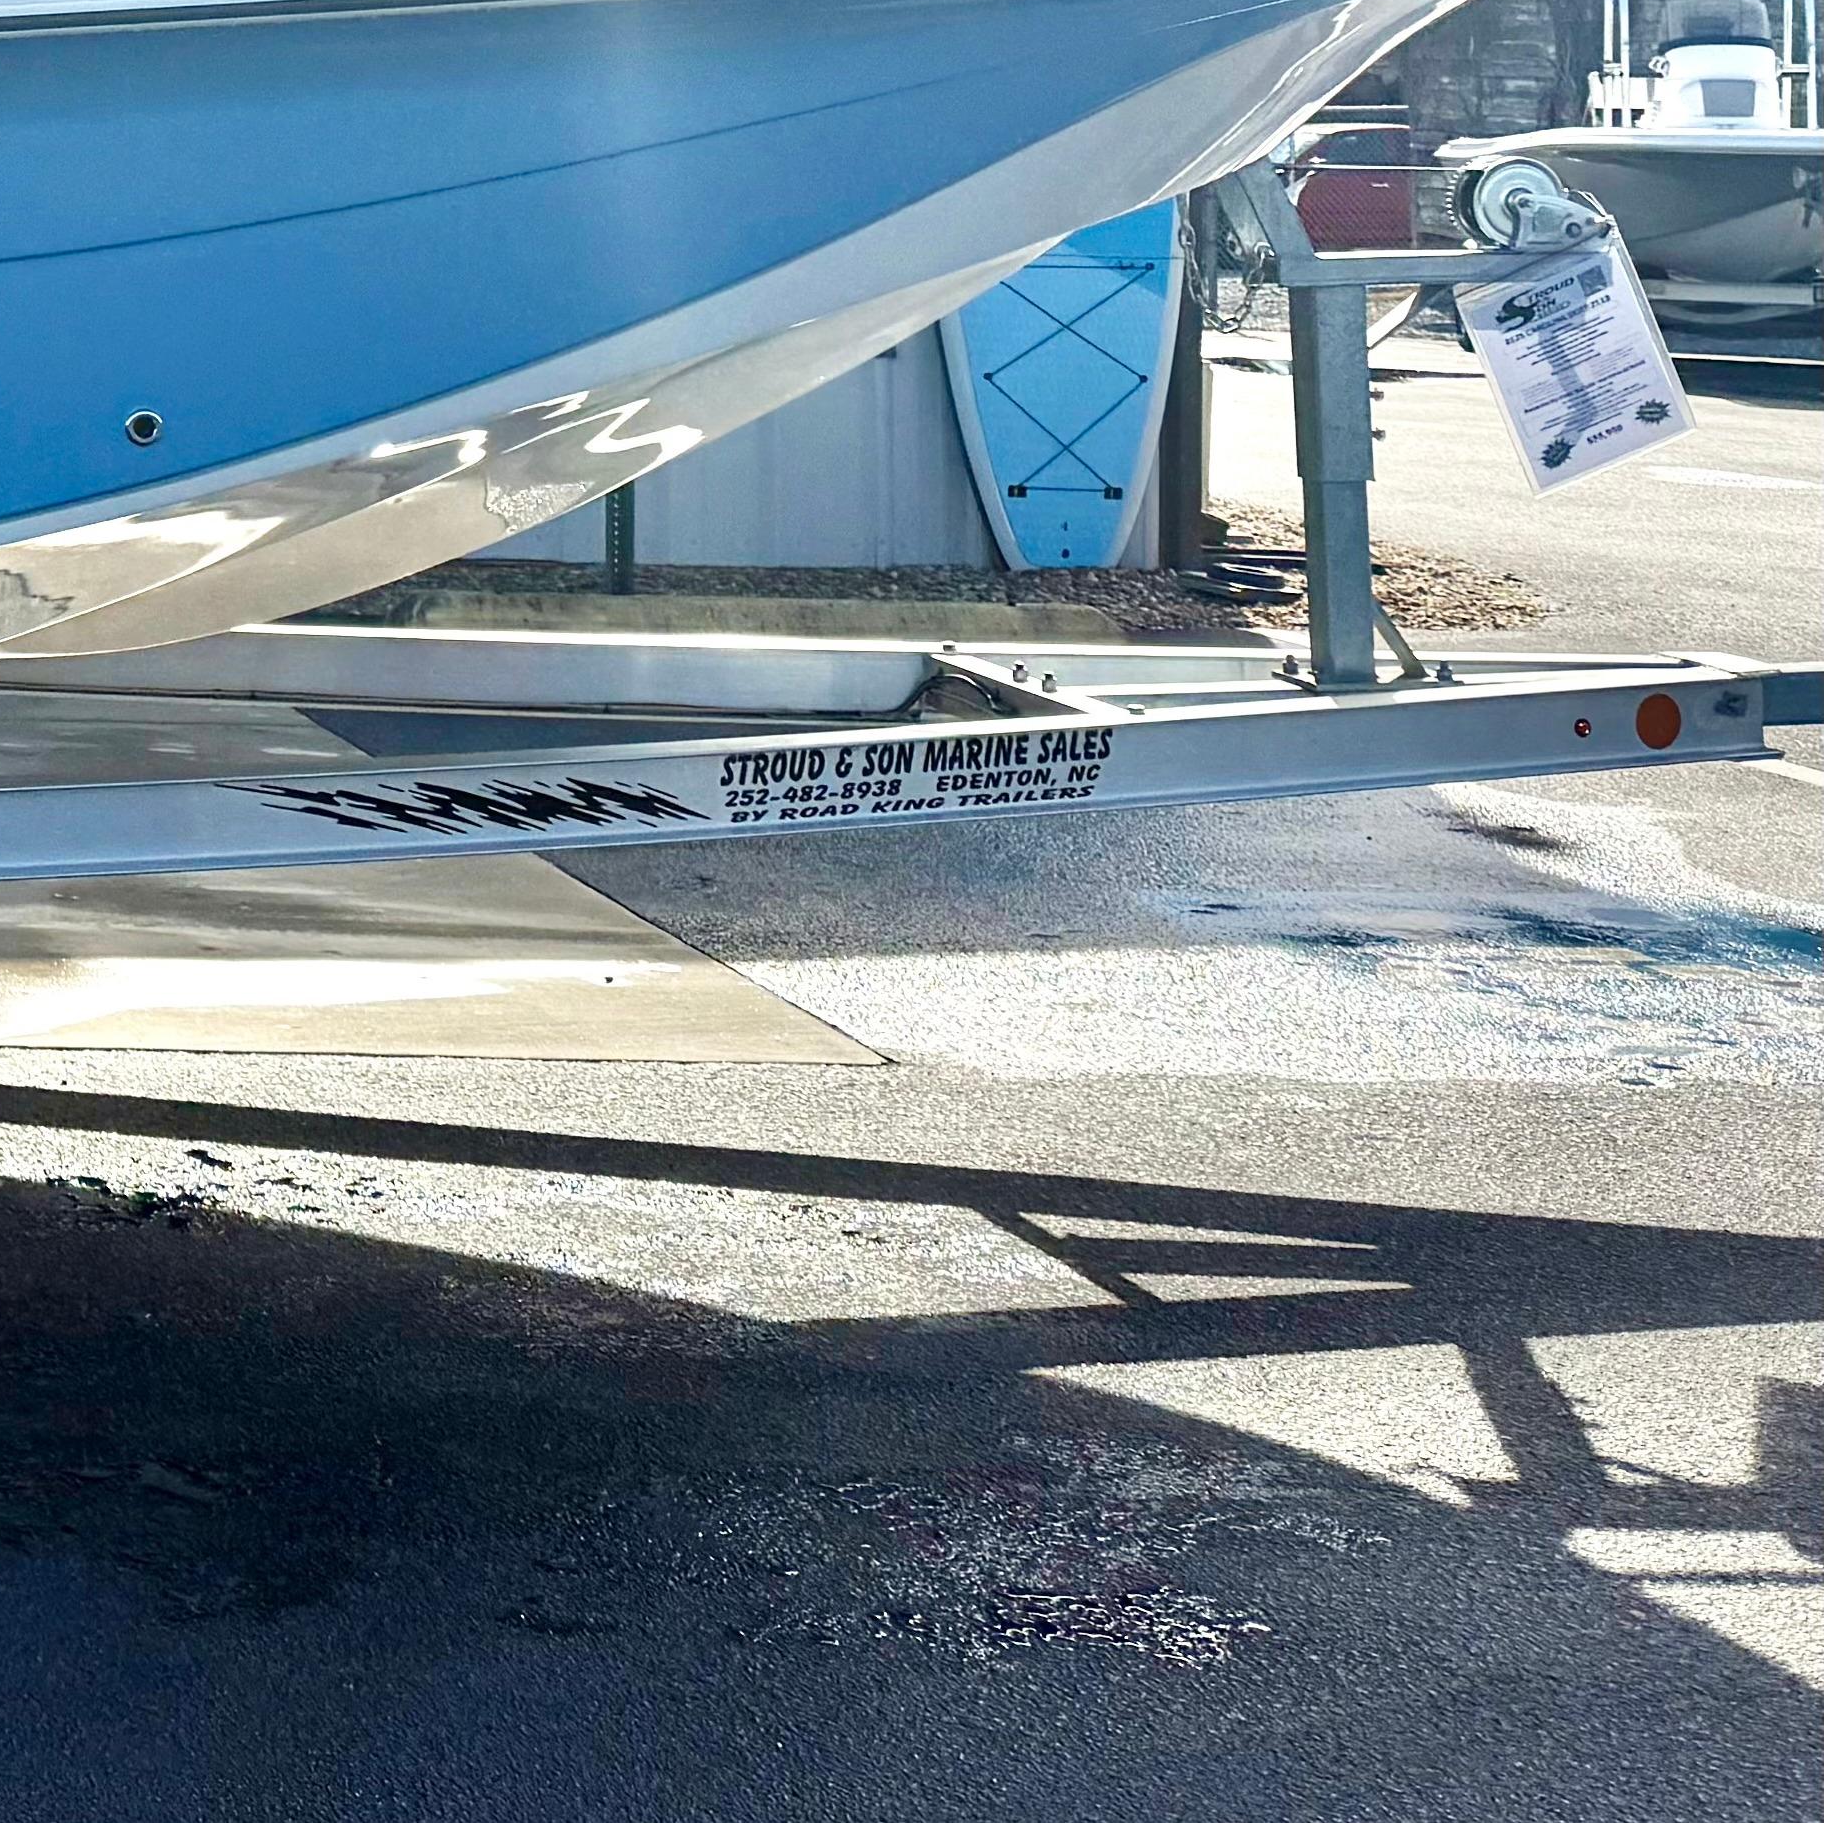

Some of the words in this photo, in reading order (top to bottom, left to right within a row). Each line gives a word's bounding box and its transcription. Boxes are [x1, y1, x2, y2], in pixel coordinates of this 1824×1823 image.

[720, 748, 825, 787] STROUD
[835, 748, 853, 778] &
[862, 741, 915, 777] SON
[923, 734, 1028, 773] MARINE
[1037, 727, 1113, 764] SALES
[724, 778, 902, 809] 252-482-8938
[936, 766, 1056, 793] EDENTON,
[1068, 764, 1101, 783] NC
[730, 809, 767, 824] BY
[779, 804, 859, 821] ROAD
[870, 795, 945, 815] KING
[957, 784, 1095, 807] TRAILERS
